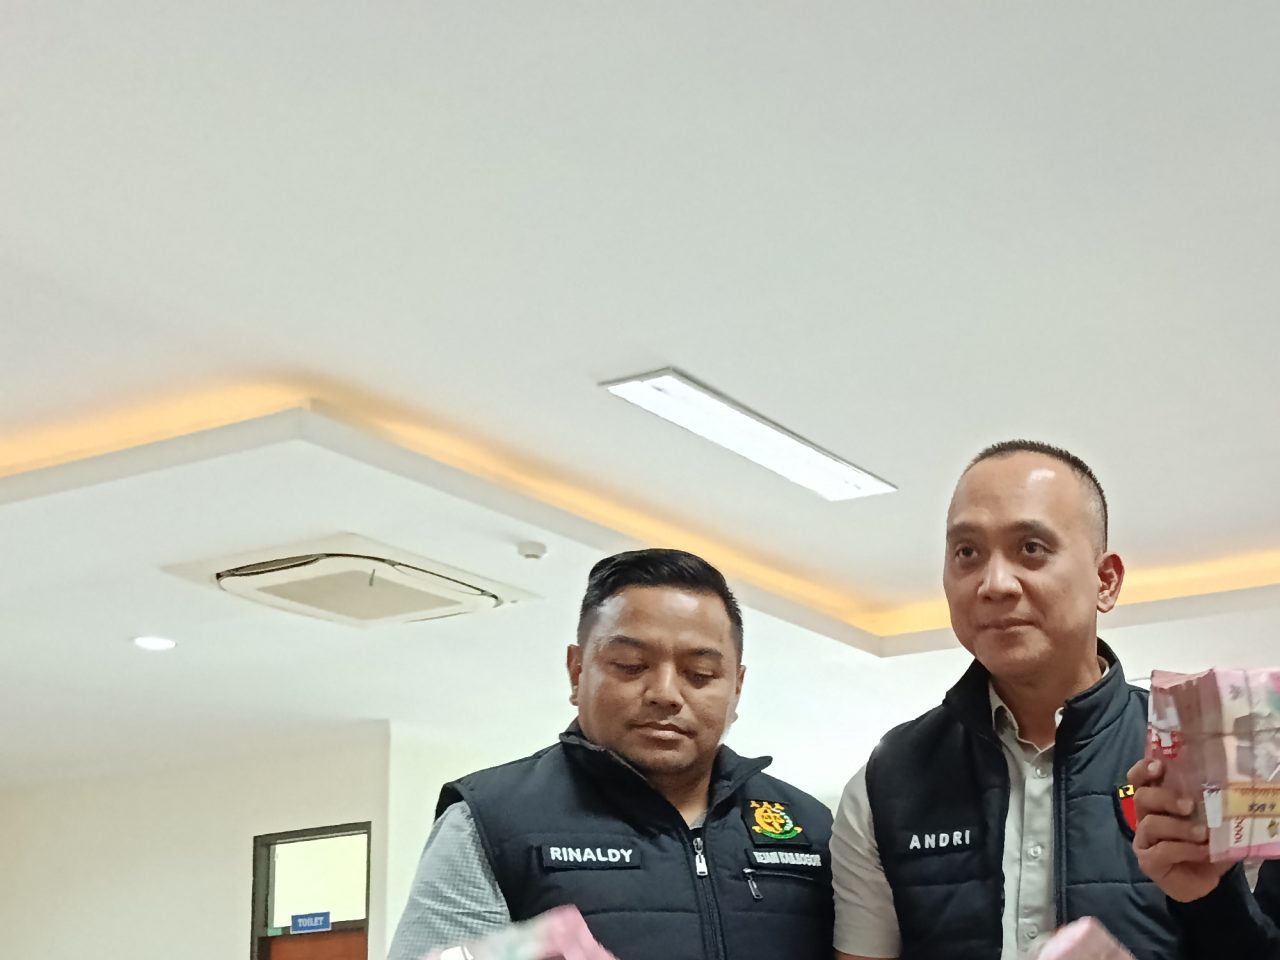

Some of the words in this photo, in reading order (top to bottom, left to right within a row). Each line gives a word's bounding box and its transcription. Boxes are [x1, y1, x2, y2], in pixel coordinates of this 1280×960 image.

[909, 829, 971, 850] ANDRI
[550, 846, 633, 863] RINALDY
[297, 916, 324, 928] TOILET
